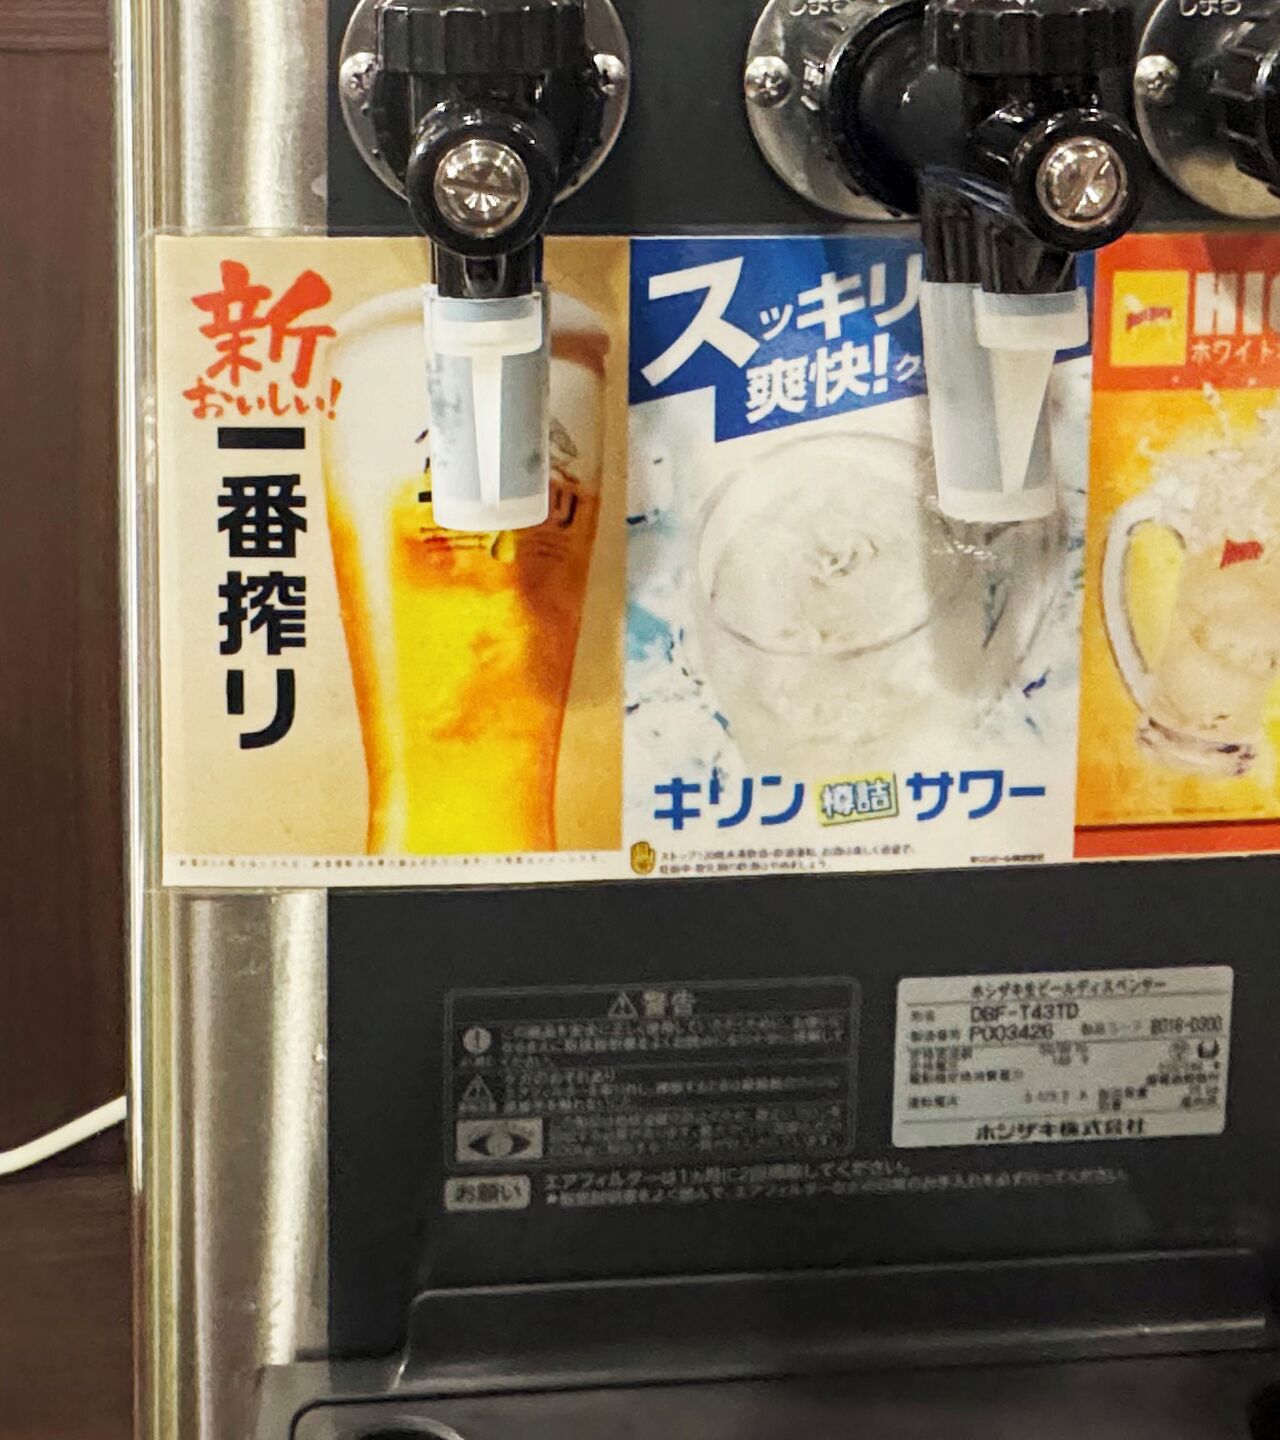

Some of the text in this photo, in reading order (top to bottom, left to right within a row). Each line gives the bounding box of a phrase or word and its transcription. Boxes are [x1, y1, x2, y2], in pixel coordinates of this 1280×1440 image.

[192, 260, 336, 389] 新
[640, 253, 923, 387] スッキリ
[183, 377, 343, 420] おいしい!
[218, 427, 308, 750] 一番搾り
